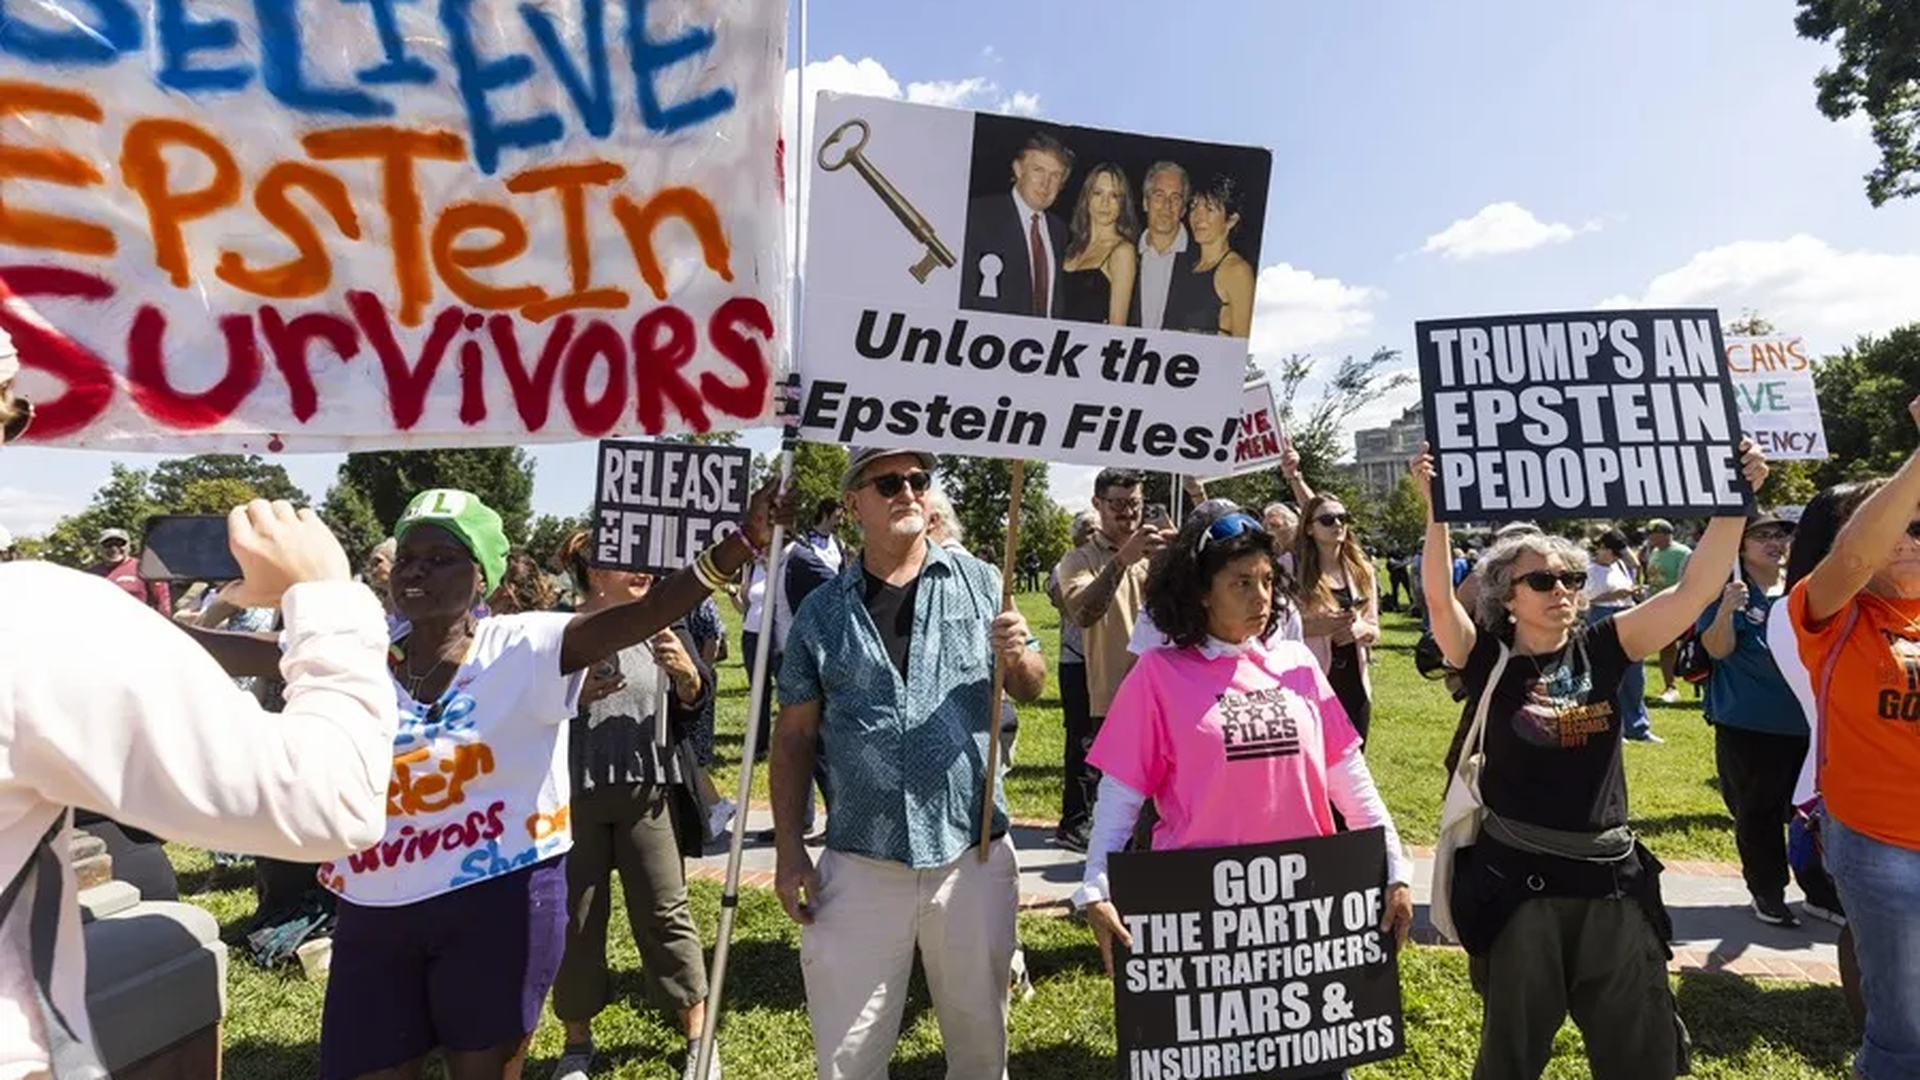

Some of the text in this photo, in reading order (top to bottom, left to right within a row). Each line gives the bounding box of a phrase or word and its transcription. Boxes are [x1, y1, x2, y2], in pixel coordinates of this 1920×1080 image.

[854, 309, 1201, 388] Unlock the
[1430, 318, 1720, 387] TRUMP'S AN
[802, 380, 1240, 463] Epstein Files!
[1435, 382, 1732, 451] EPSTEIN
[602, 448, 743, 513] RELEASE
[1440, 444, 1744, 512] PEDOPHILE
[597, 509, 621, 563] THE
[1222, 718, 1298, 744] FILES
[1212, 854, 1308, 907] GOP
[1123, 888, 1382, 955] THE PARTY OF
[1126, 931, 1388, 993] SEX TRAFFICKERS,
[1175, 982, 1355, 1042] LIARS &
[1129, 1015, 1395, 1080] INSURRECTIONISTS
